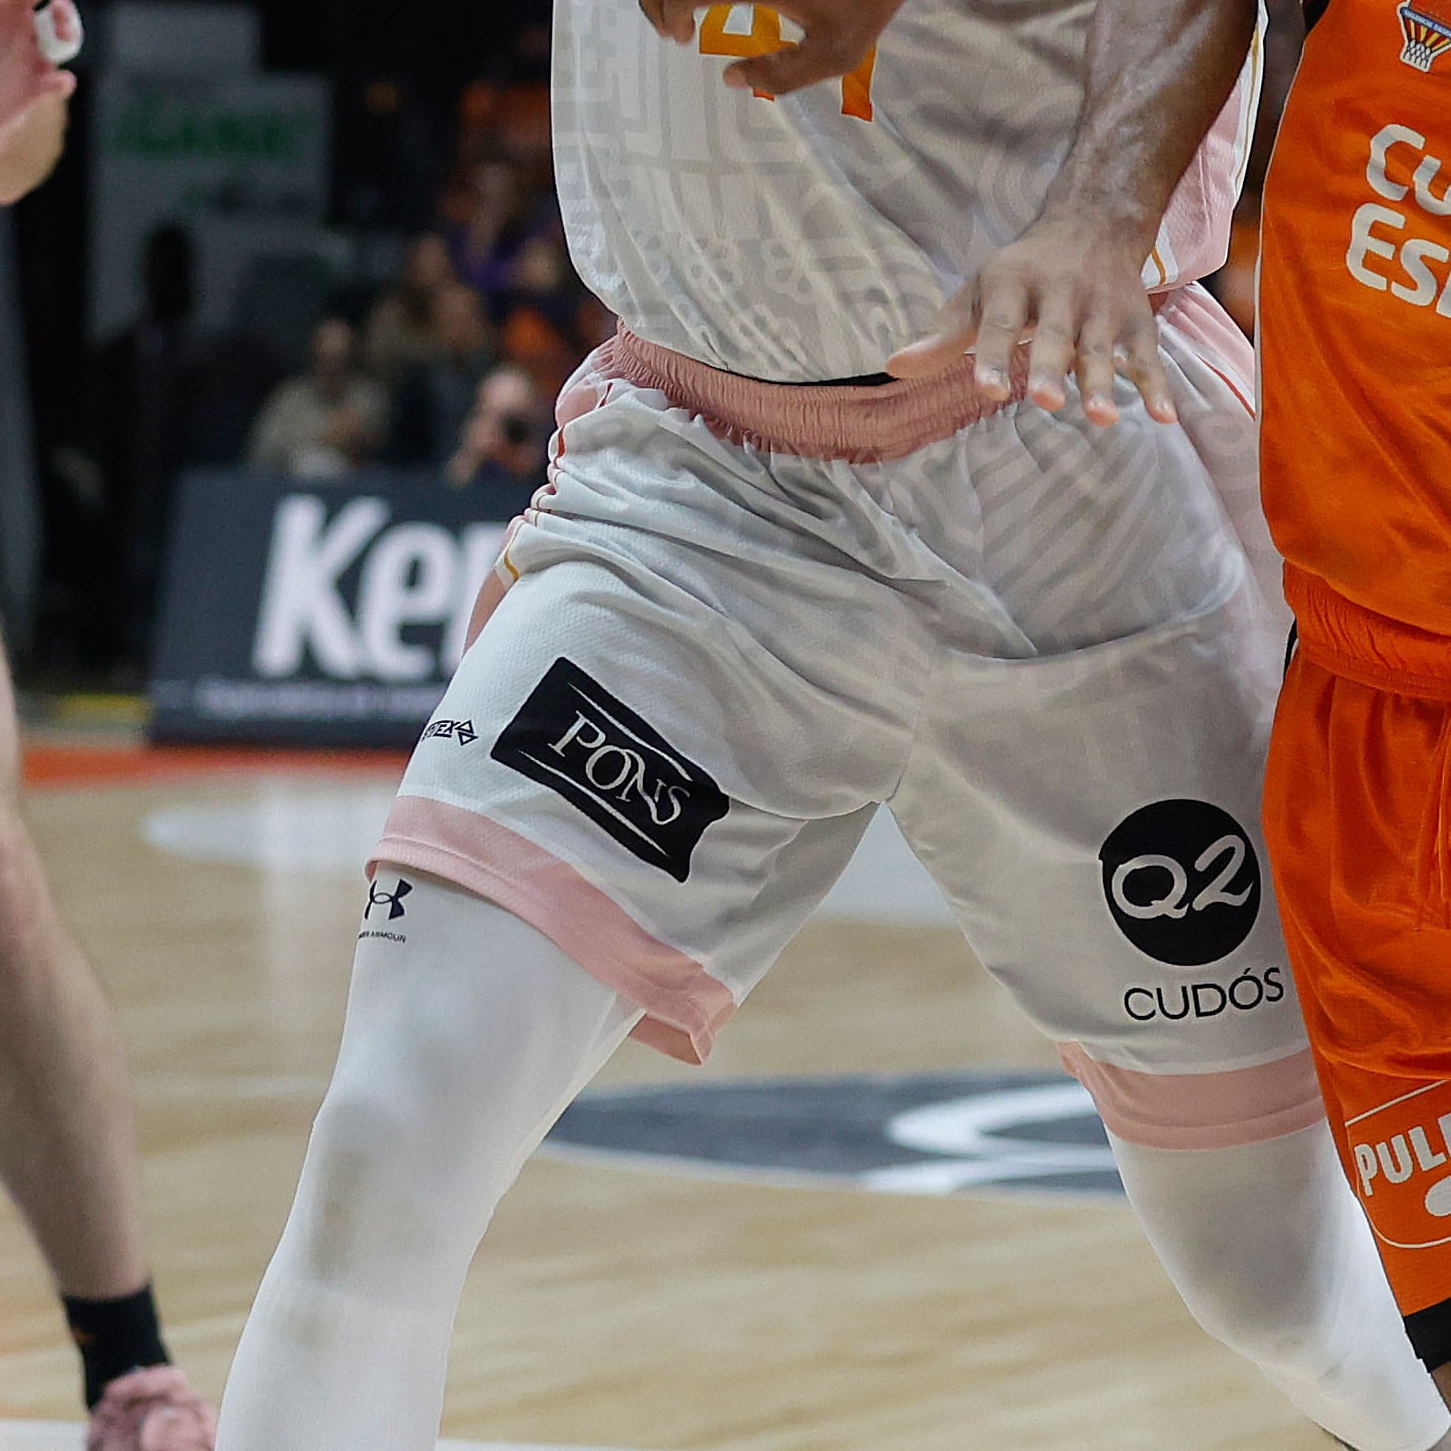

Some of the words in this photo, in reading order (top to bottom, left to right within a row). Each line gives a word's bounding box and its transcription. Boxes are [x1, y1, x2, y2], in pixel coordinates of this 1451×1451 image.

[545, 709, 691, 826] PONS
[1111, 834, 1254, 920] Q2
[1123, 966, 1285, 1021] CUDÓS
